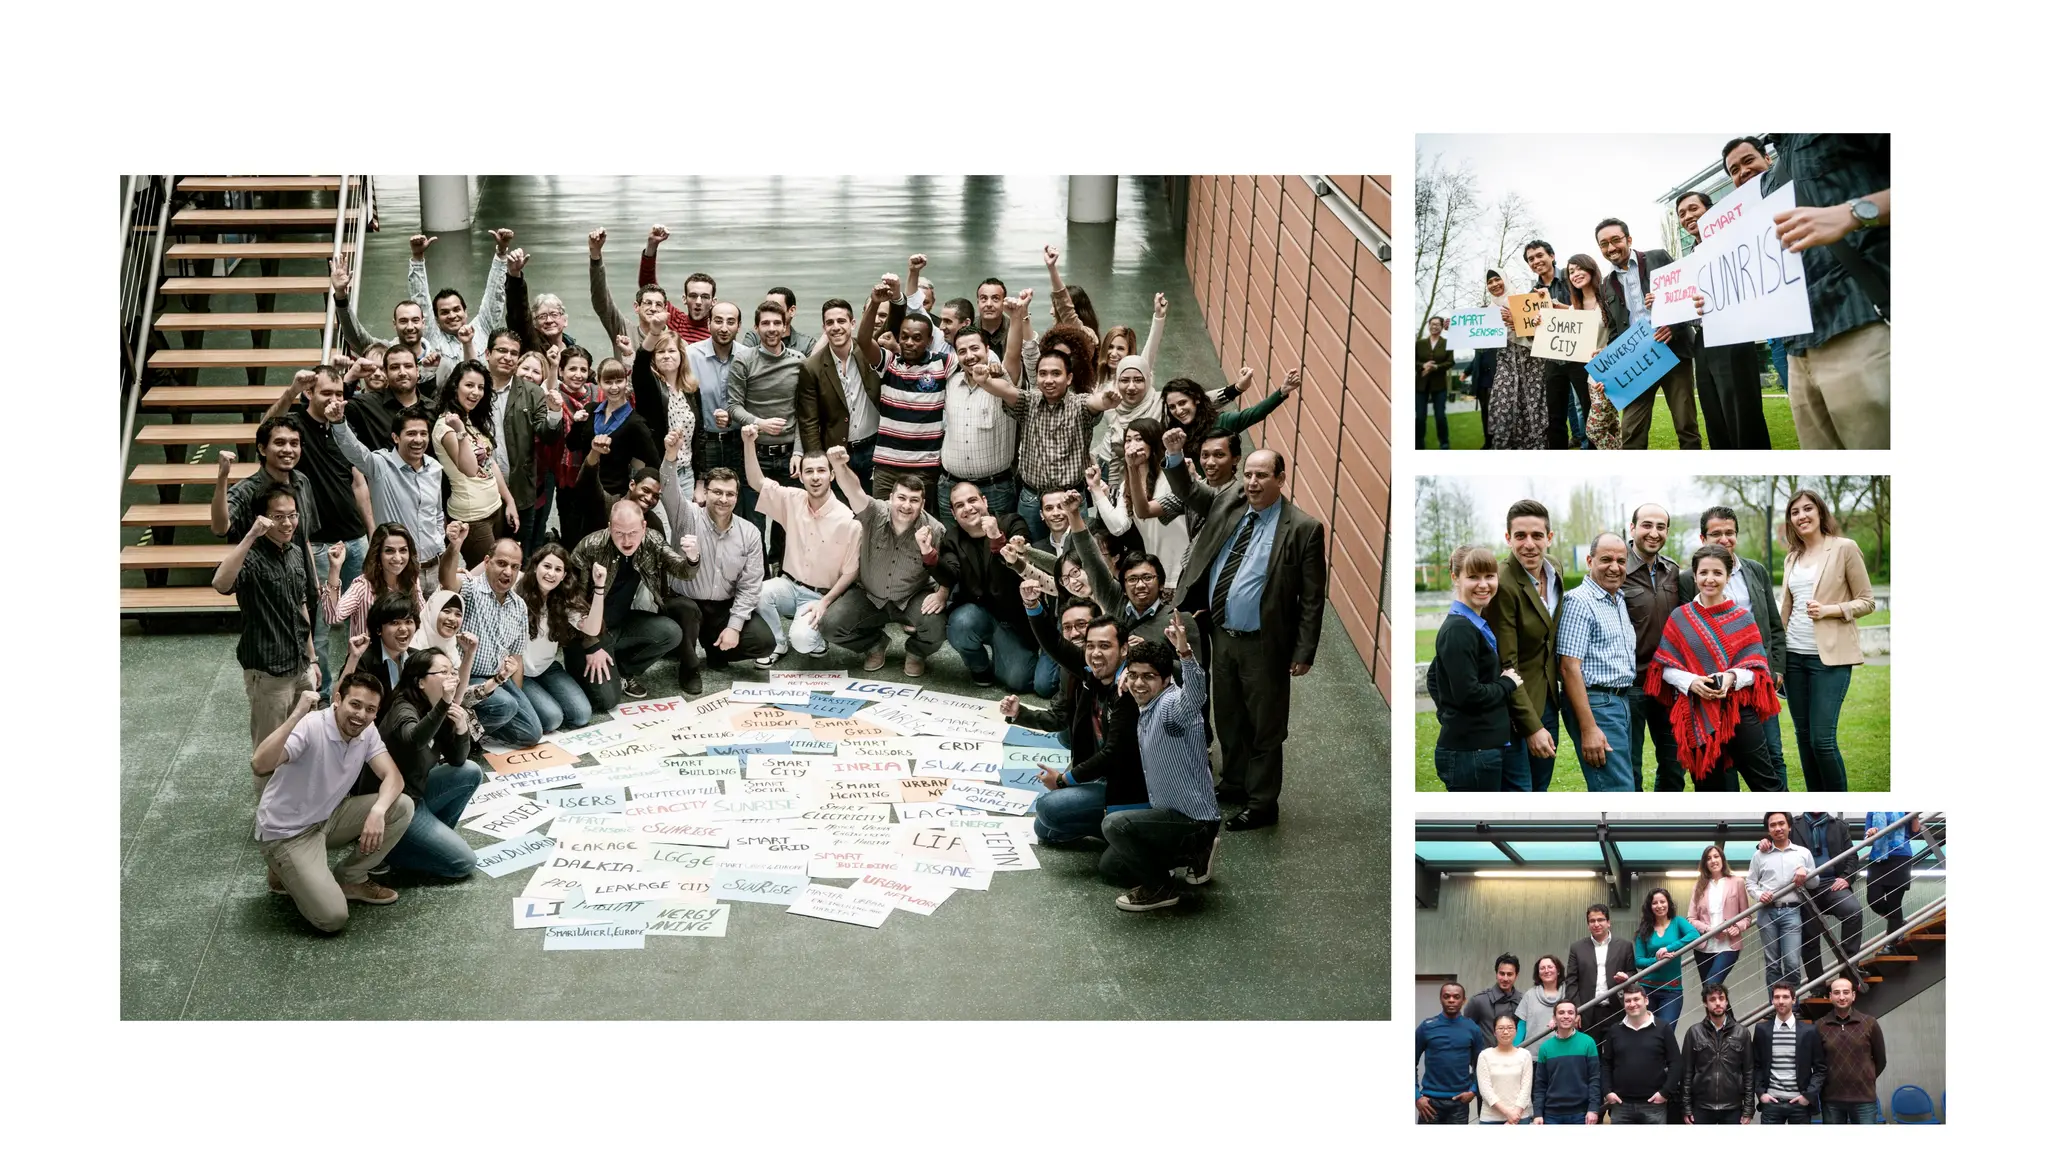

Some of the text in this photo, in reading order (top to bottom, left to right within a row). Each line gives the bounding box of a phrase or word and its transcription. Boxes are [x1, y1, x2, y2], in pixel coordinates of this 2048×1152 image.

[1698, 226, 1801, 315] SUNRISE
[1652, 269, 1682, 291] SMART
[1664, 285, 1698, 304] BUILDIN
[1451, 313, 1486, 327] SMART
[1547, 316, 1584, 335] SMART
[1469, 327, 1505, 338] SENSORS
[1550, 335, 1578, 357] CITY
[1614, 347, 1662, 389] LILLE 1
[620, 700, 680, 716] ERDF
[753, 710, 785, 718] PHD
[741, 720, 800, 728] STUDENT
[814, 720, 860, 729] SMART
[557, 728, 604, 746] SMART
[671, 731, 735, 741] METERING
[844, 728, 882, 736] GRID
[587, 733, 623, 747] CITY
[840, 739, 889, 747] SMART
[599, 744, 666, 759] SUNRIS
[713, 746, 764, 756] WATER
[938, 741, 985, 751] ERDF
[855, 747, 914, 757] SENSORS
[660, 759, 704, 768] SMART
[762, 758, 812, 768] SMART
[1008, 752, 1073, 764] CRÉACIT
[679, 768, 737, 776] BUILDING
[770, 767, 807, 778] CITY
[832, 762, 903, 772] INRIA
[494, 770, 540, 782] SMART
[510, 773, 577, 790] METERING
[744, 780, 785, 788] SMART
[831, 781, 881, 790] SMART
[902, 778, 949, 788] URBAN
[829, 791, 890, 800] HEATING
[951, 783, 1007, 799] WATER
[713, 799, 796, 813] SUNRISE
[819, 802, 866, 811] SMART
[965, 795, 1030, 810] QUALITY
[482, 800, 548, 833] PROJEX
[801, 811, 886, 822] ELECTRICITY
[642, 822, 723, 837] SUNRISE
[949, 819, 1004, 829] ENERGY
[736, 836, 791, 846] SMART
[768, 844, 810, 852] GRID
[814, 852, 865, 861] SMART
[835, 861, 899, 871] BUILDING
[914, 862, 977, 878] IXSANE
[594, 881, 671, 894] LEAKAGE
[722, 879, 798, 895] SUNRISE
[863, 874, 912, 892] URBAN
[883, 890, 939, 909] NETWORK
[656, 908, 722, 921] NERGY
